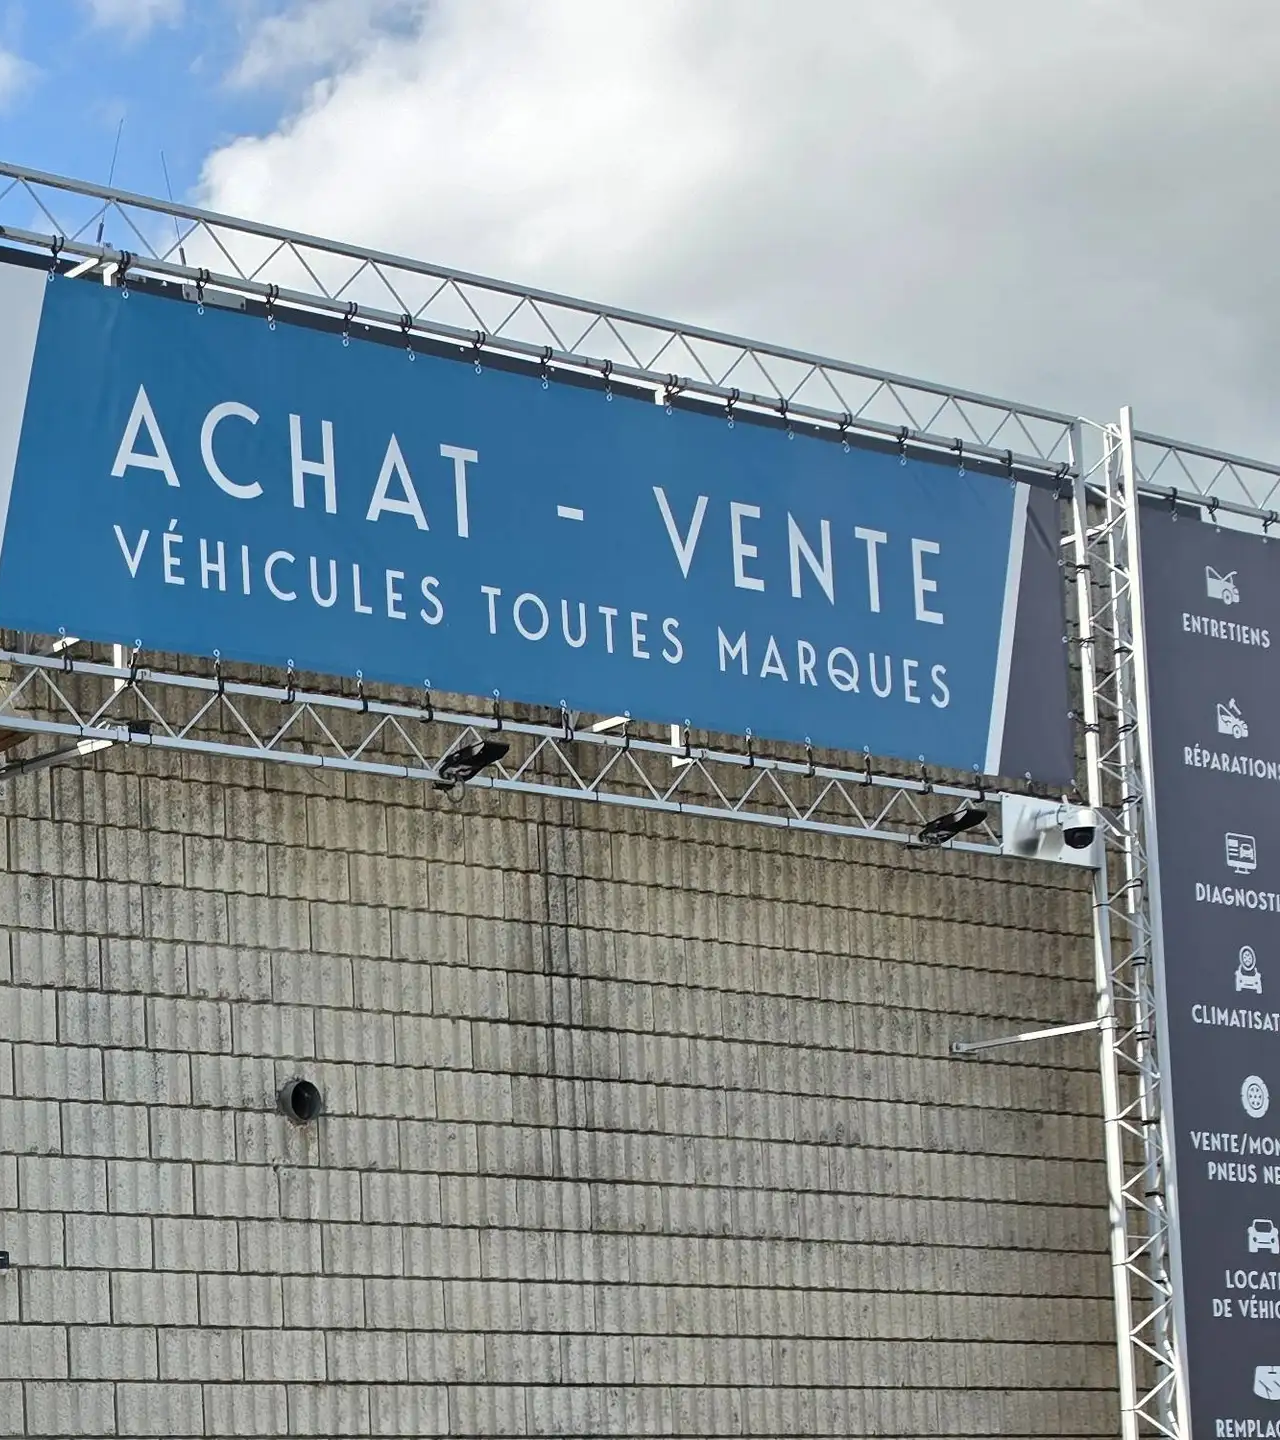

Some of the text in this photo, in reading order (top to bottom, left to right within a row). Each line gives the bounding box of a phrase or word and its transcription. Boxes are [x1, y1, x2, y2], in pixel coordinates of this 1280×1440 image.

[111, 384, 944, 626] ACHAT - VENTE
[113, 519, 951, 709] VÉHICULES TOUTES MARQUES
[1183, 613, 1271, 648] ENTRETIENS
[1192, 1004, 1280, 1031] CLIMATISAT
[1208, 1162, 1257, 1183] PNEUS
[1212, 1298, 1233, 1317] DE
